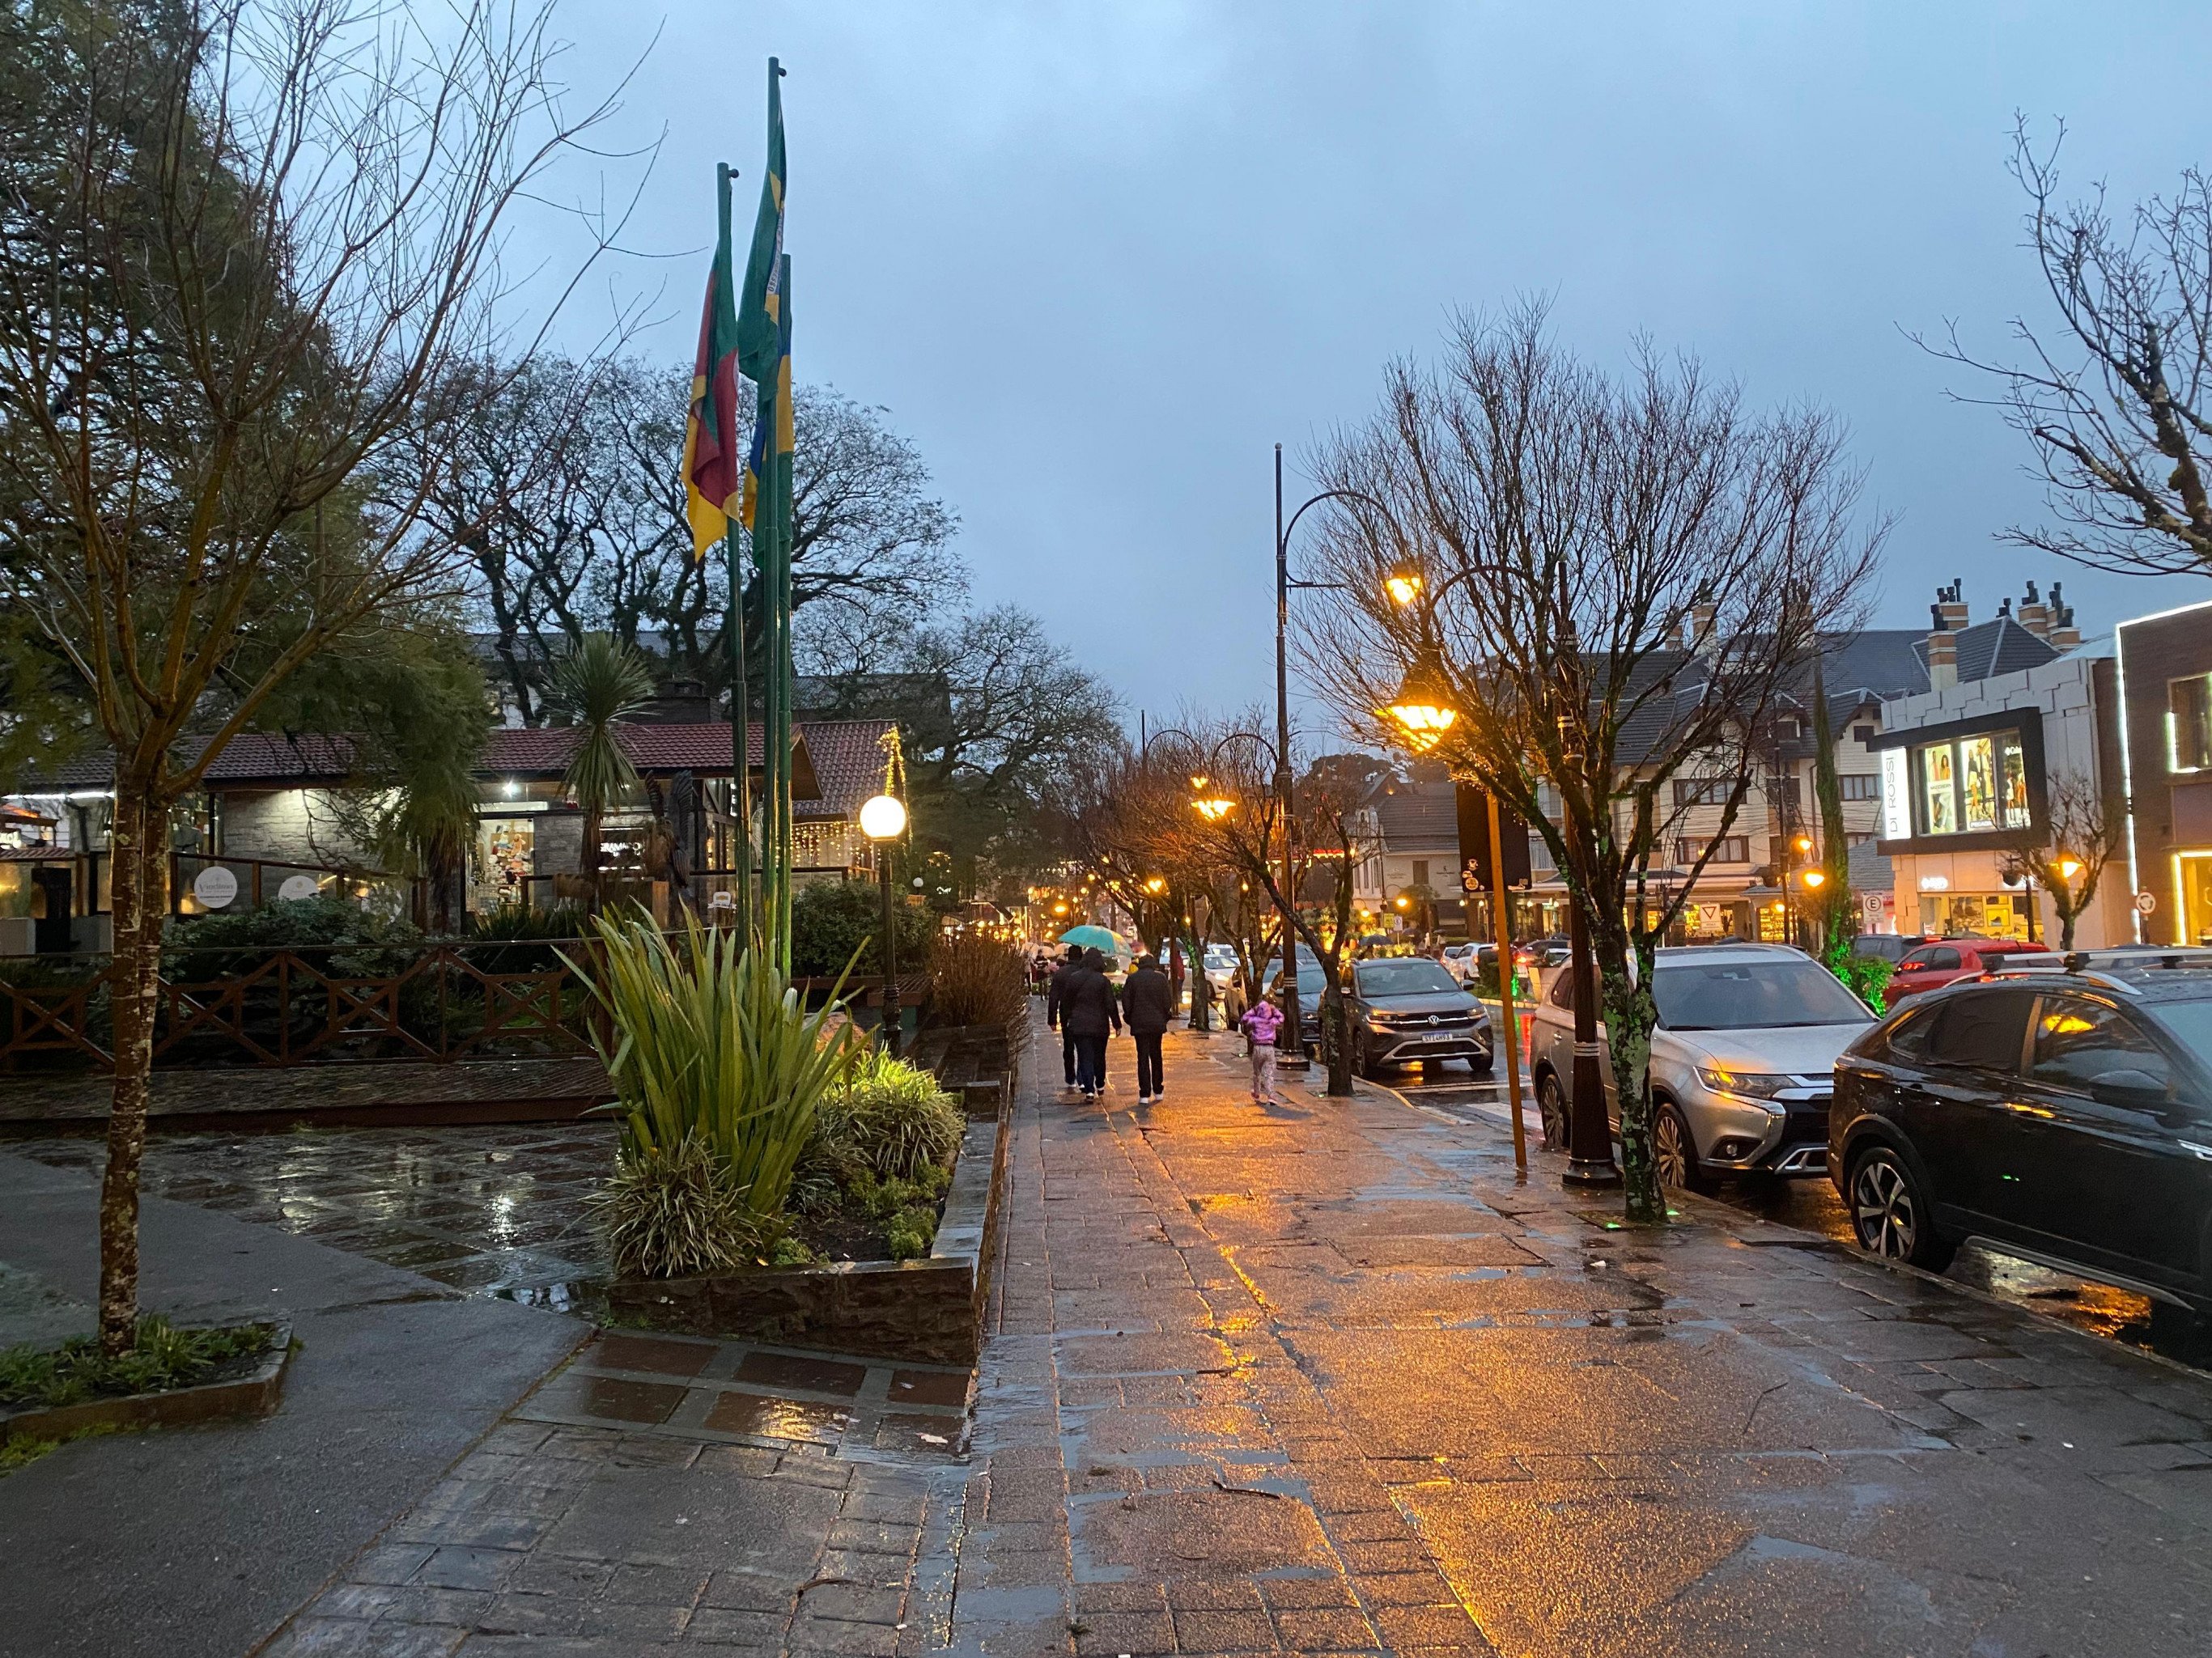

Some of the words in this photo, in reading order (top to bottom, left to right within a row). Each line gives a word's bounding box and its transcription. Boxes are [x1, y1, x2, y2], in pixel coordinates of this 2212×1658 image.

[1886, 757, 1896, 808] ROSSI
[1890, 817, 1898, 833] DI
[1870, 899, 1876, 909] E
